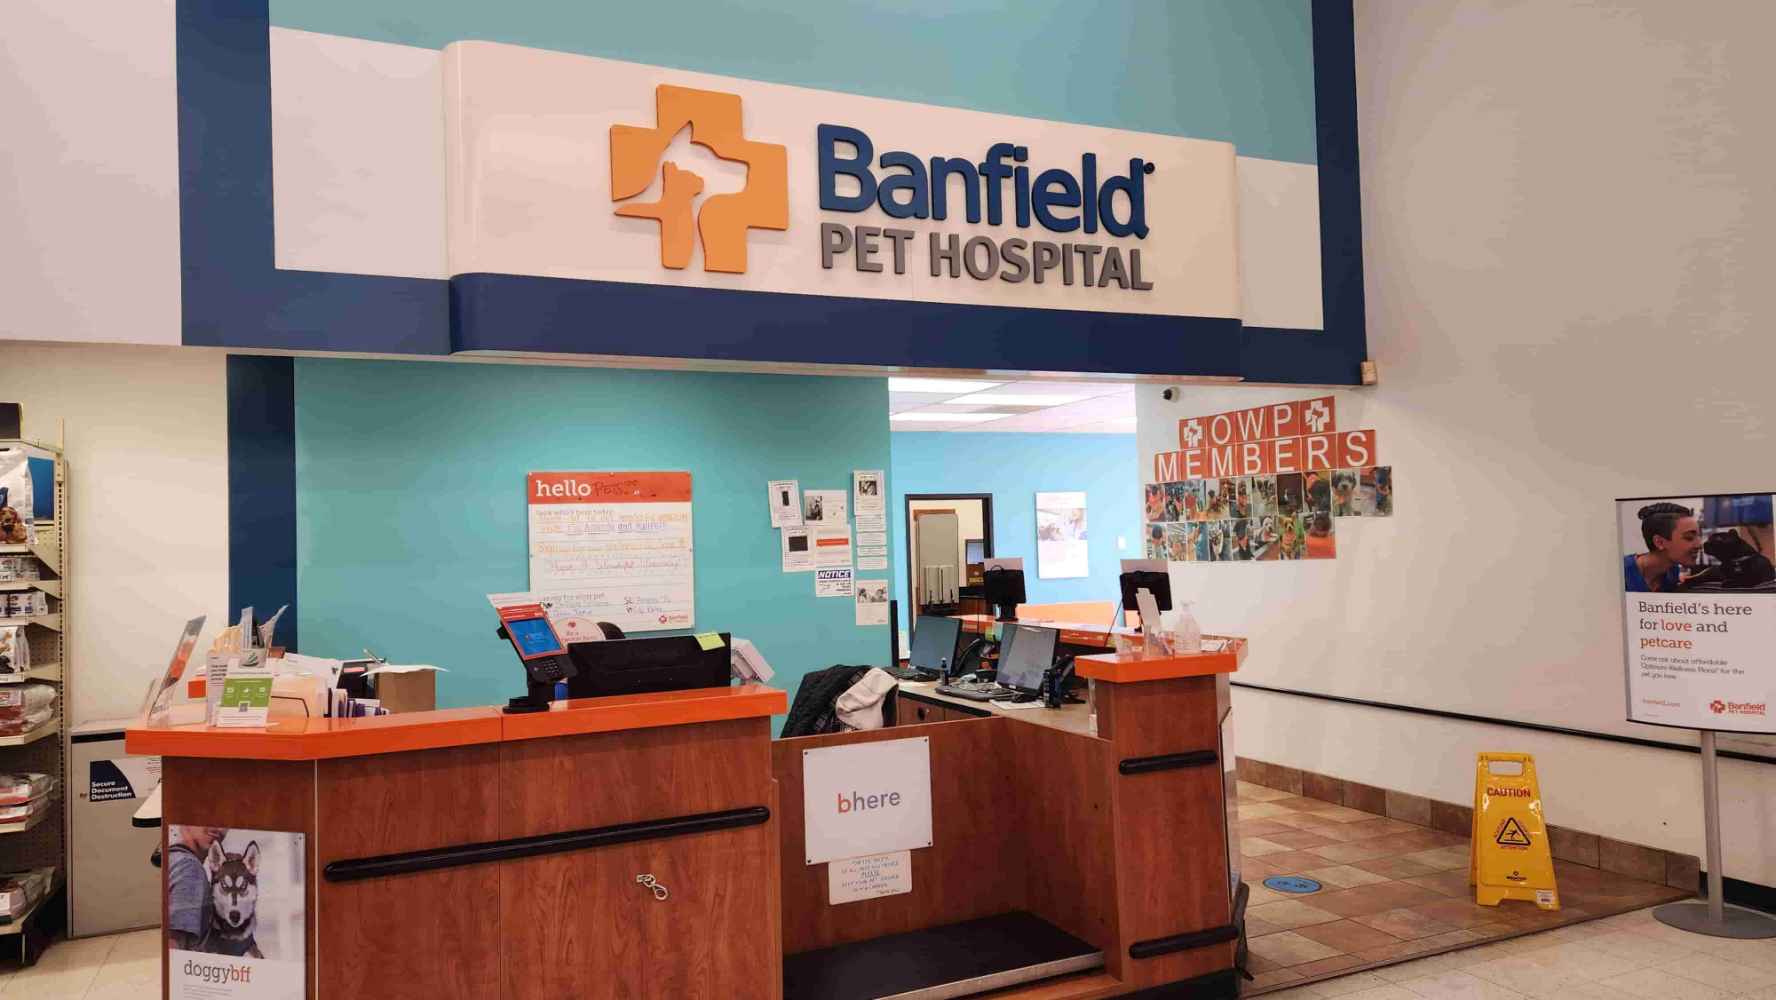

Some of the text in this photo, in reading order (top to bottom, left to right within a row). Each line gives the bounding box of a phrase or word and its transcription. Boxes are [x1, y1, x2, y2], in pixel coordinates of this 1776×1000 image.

[817, 123, 1151, 239] Banfield
[821, 223, 1154, 290] PET HOSPITAL
[1211, 404, 1293, 445] OWP
[1159, 431, 1369, 481] MEMBERS
[535, 479, 592, 497] hello
[816, 571, 849, 579] NOTICE
[1639, 601, 1753, 616] Banfield's here
[1639, 618, 1729, 633] for love and
[1640, 636, 1693, 650] petcare
[91, 792, 132, 800] Destruction
[1487, 787, 1531, 798] CAUTION
[838, 791, 902, 814] bhere
[184, 960, 252, 984] doggybff
